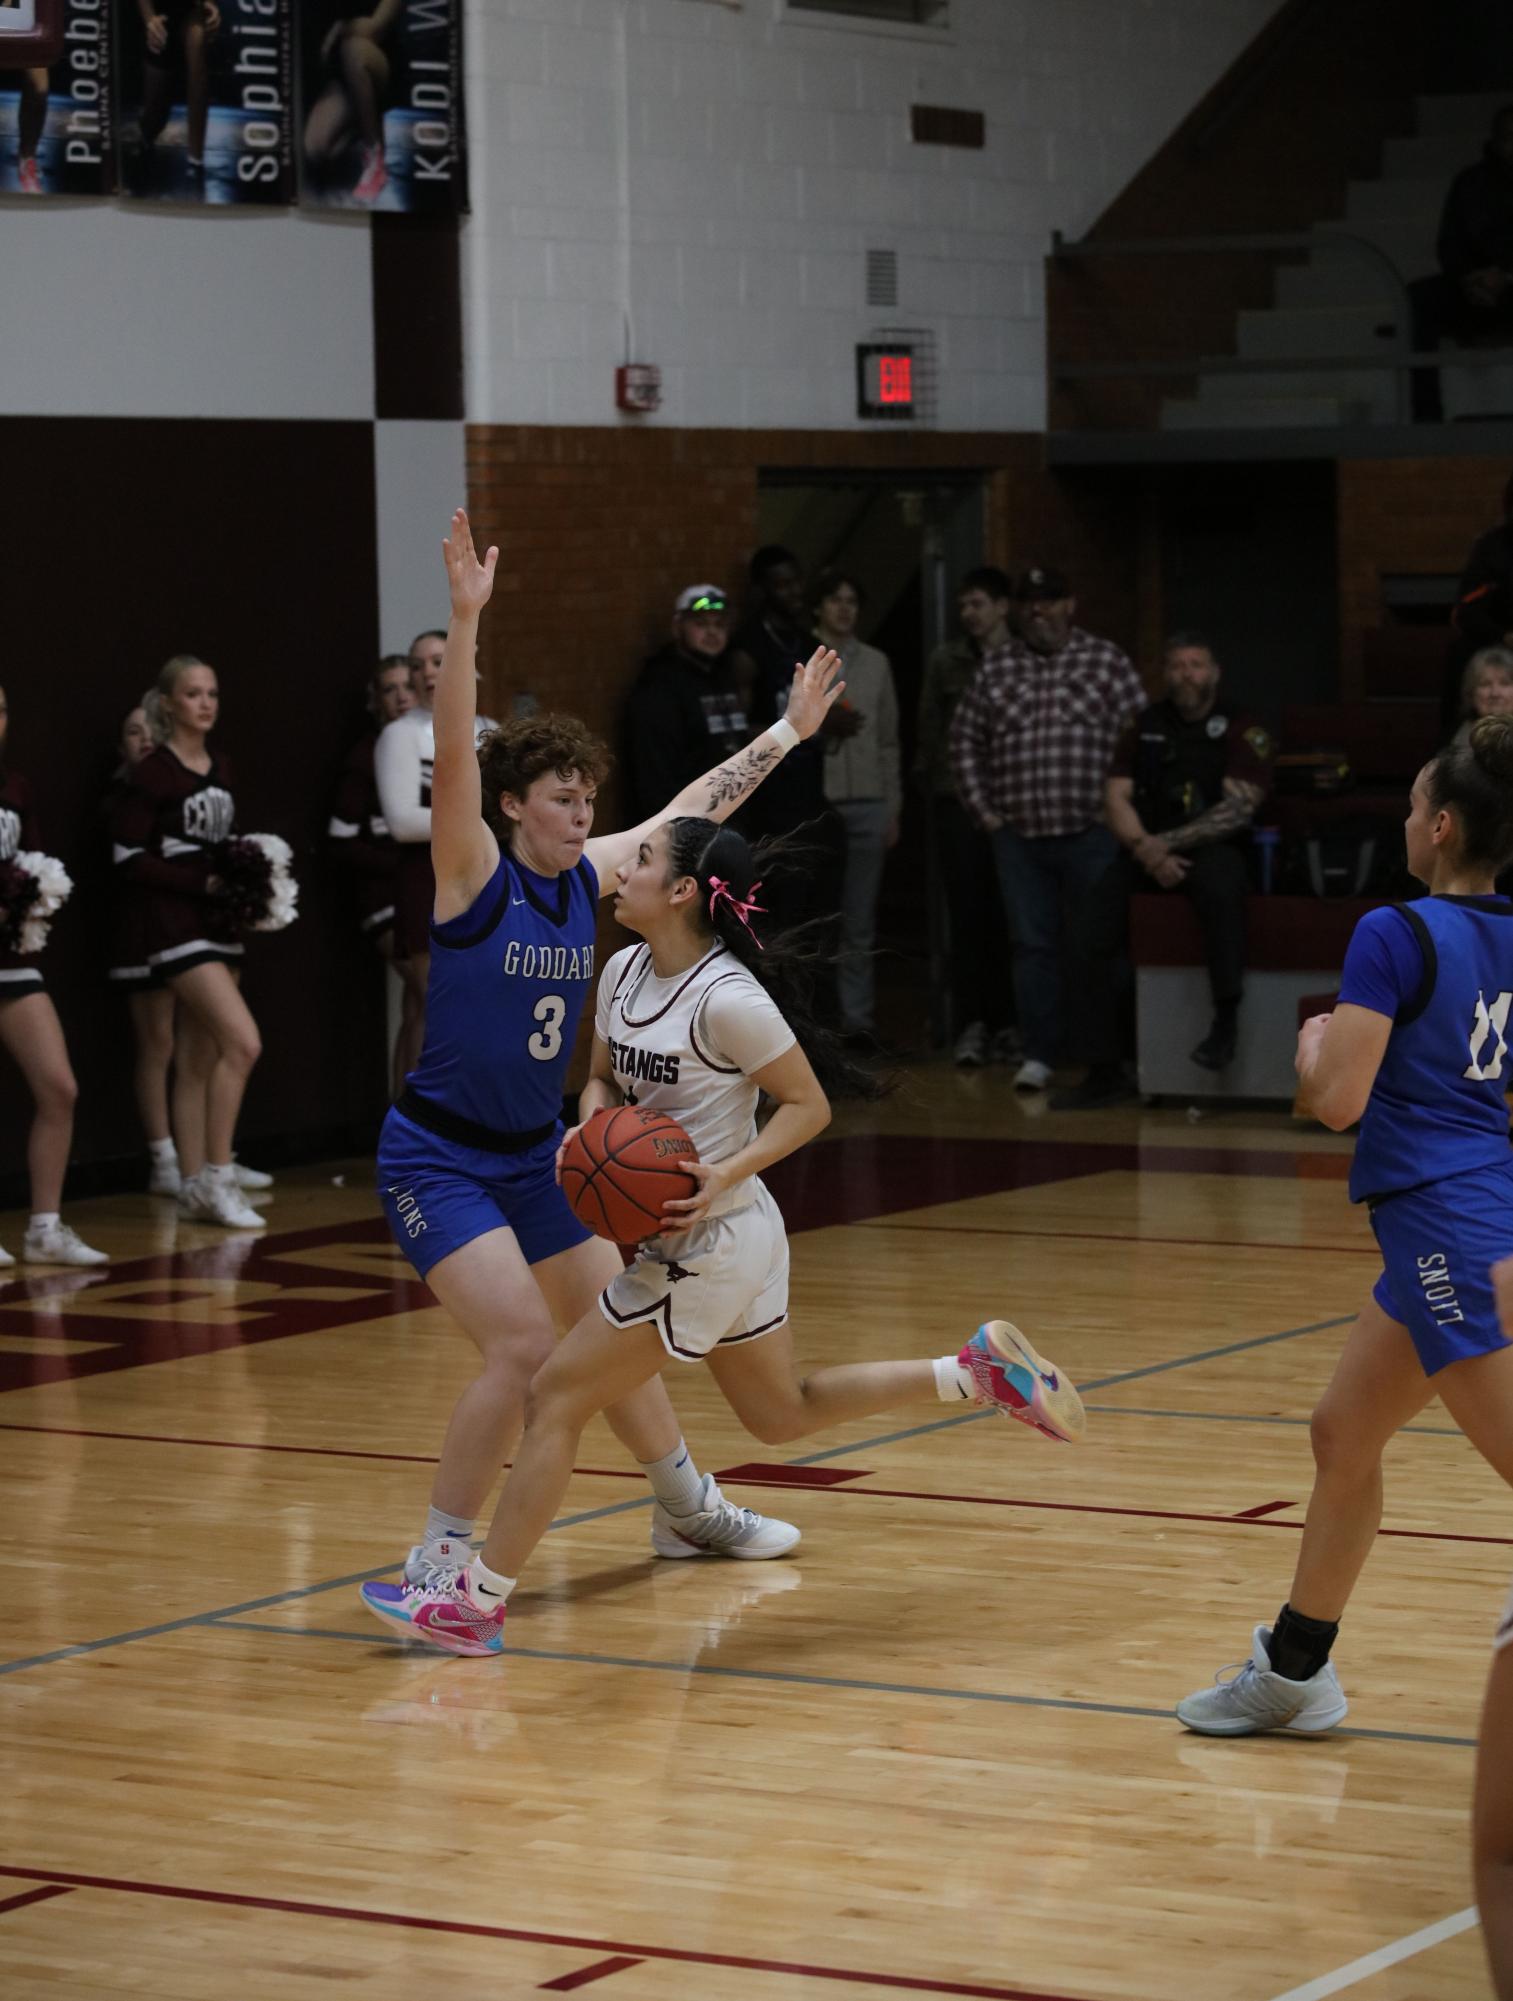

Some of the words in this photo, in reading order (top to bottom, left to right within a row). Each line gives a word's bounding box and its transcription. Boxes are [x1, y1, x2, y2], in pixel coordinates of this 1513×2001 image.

[232, 0, 283, 182] Sophia
[409, 60, 451, 181] KODI
[504, 940, 594, 980] GODDAR
[528, 995, 566, 1061] 3
[608, 1036, 680, 1085] STANGS
[1416, 1252, 1464, 1326] LIONS
